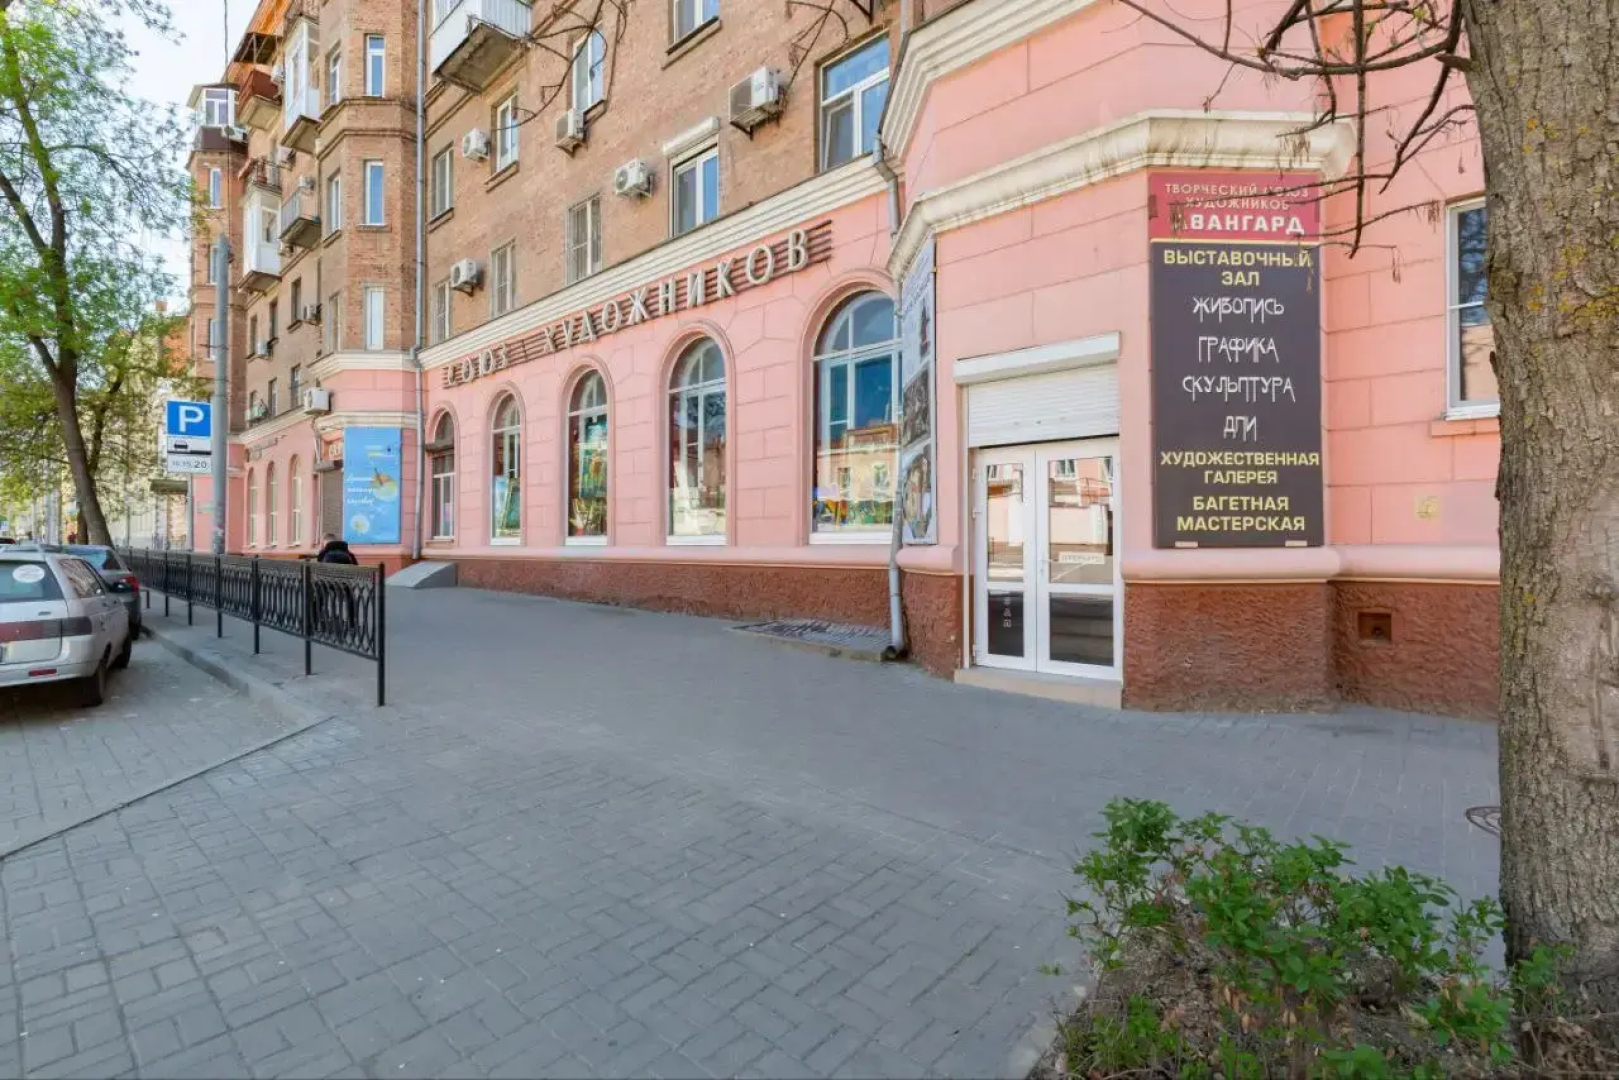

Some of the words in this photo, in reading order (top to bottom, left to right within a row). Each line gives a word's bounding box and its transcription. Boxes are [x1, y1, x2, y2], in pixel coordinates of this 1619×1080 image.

[1165, 182, 1257, 196] ТВОРЧЕСКИЙ
[1221, 271, 1260, 287] ЗАЛ
[542, 227, 810, 354] ХУДОЖНИКОВ
[1192, 296, 1285, 324] ЖИВОПИСЬ
[1198, 336, 1280, 363] ГРАФИКА
[1182, 376, 1296, 403] СКУЛЬПТУРА
[1223, 415, 1258, 442] ДПИ
[194, 461, 207, 469] 20
[1160, 451, 1320, 468] ХУДОЖЕСТВЕННАЯ
[1203, 470, 1278, 484] ГАЛЕРЕЯ
[1193, 496, 1289, 511] БАГЕТНАЯ
[1176, 516, 1306, 531] МАСТЕРСКАЯ
